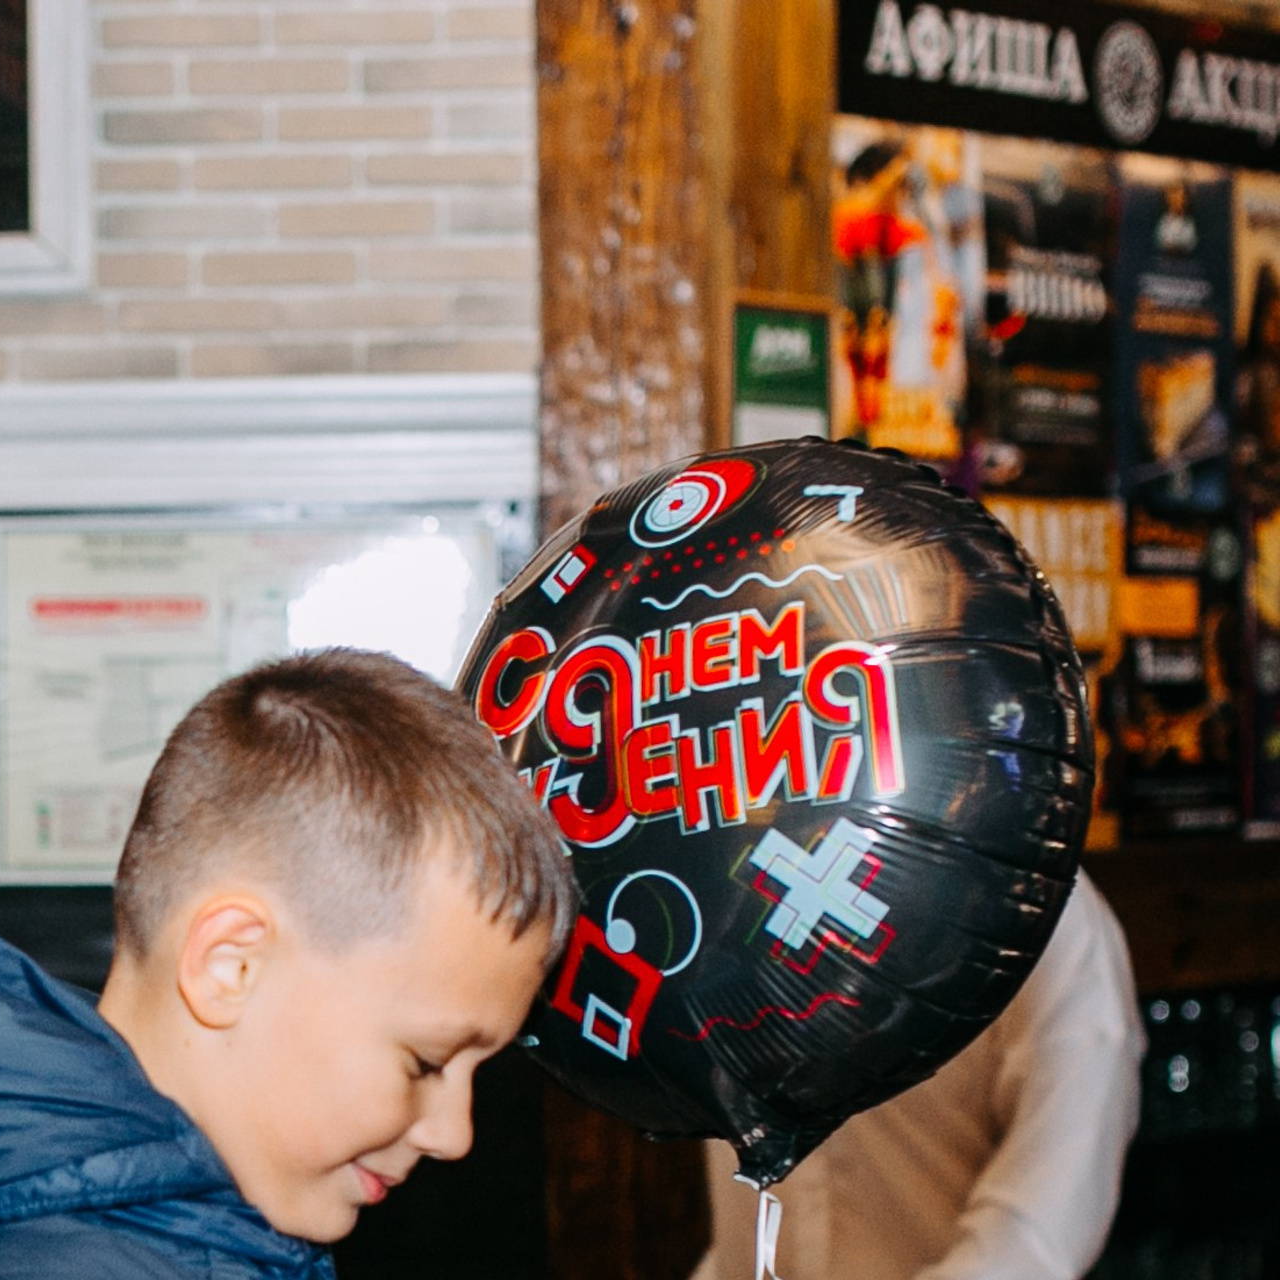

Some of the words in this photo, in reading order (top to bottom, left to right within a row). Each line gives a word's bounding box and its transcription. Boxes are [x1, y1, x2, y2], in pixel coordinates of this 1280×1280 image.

[865, 0, 1089, 102] АФИША
[1168, 47, 1280, 148] АКЦ
[475, 626, 557, 740] С
